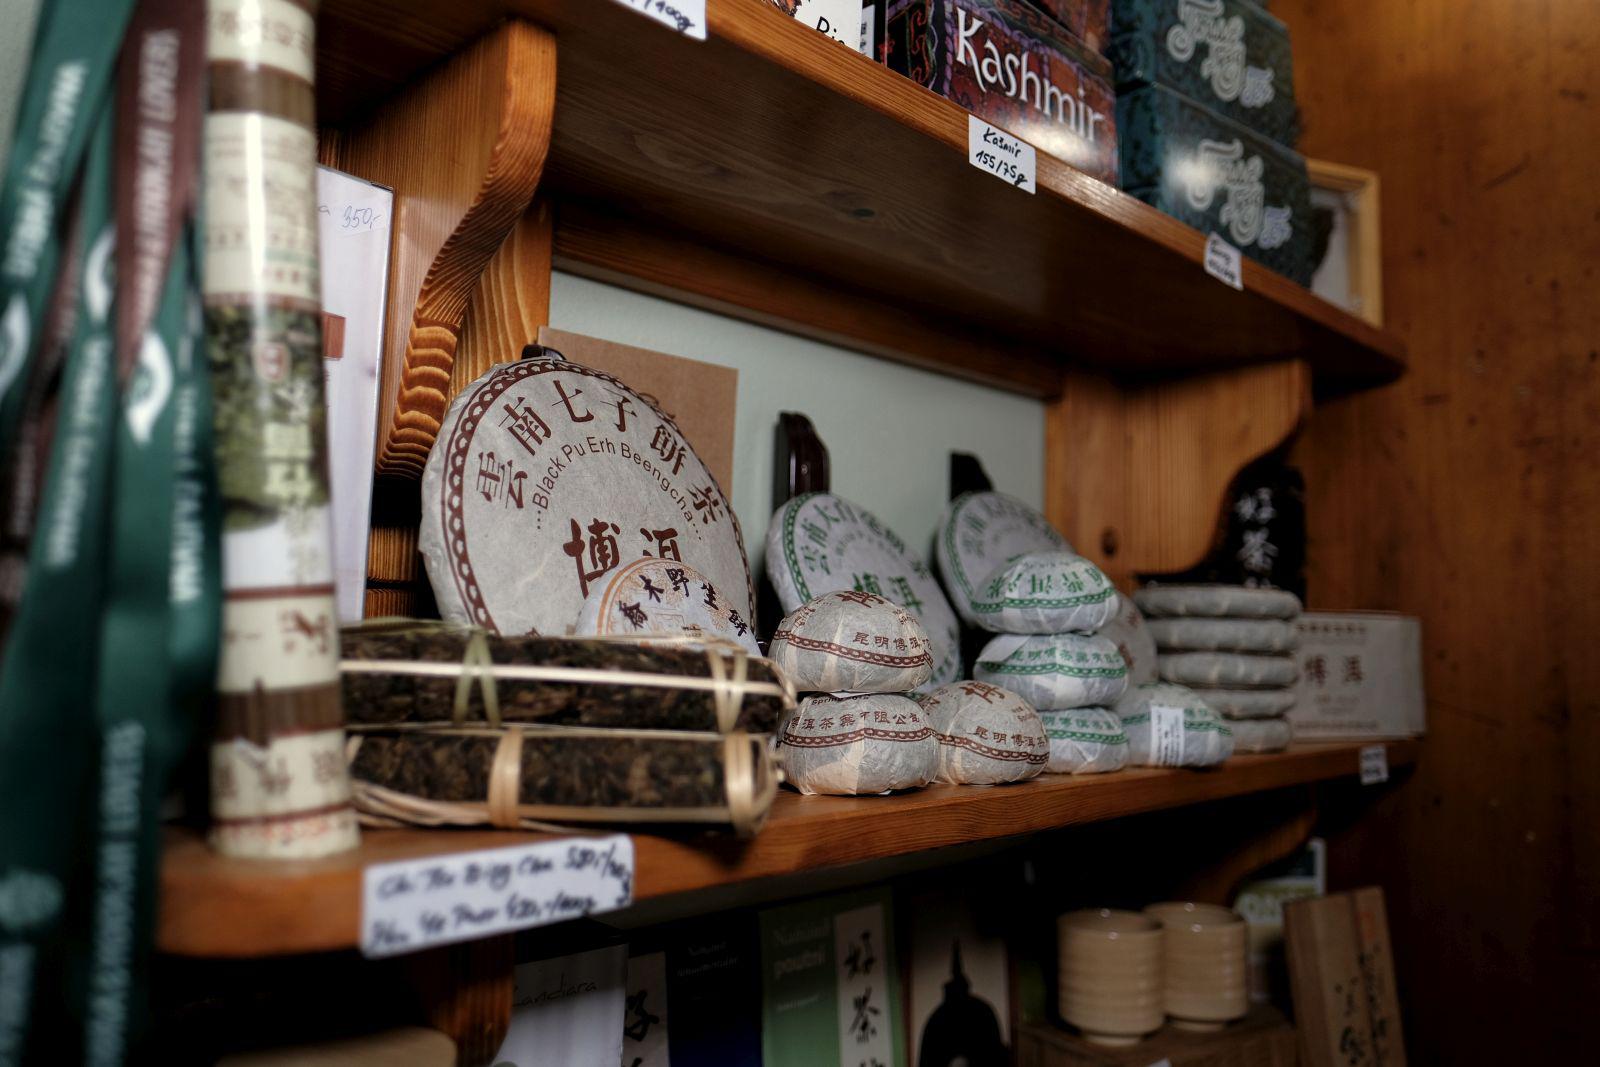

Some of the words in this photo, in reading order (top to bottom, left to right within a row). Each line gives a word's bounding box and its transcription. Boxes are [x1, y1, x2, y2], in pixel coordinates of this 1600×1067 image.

[956, 6, 1105, 142] Kashmir
[975, 149, 1028, 187] 155/75g
[561, 443, 586, 463] Pu
[586, 436, 616, 455] Erh
